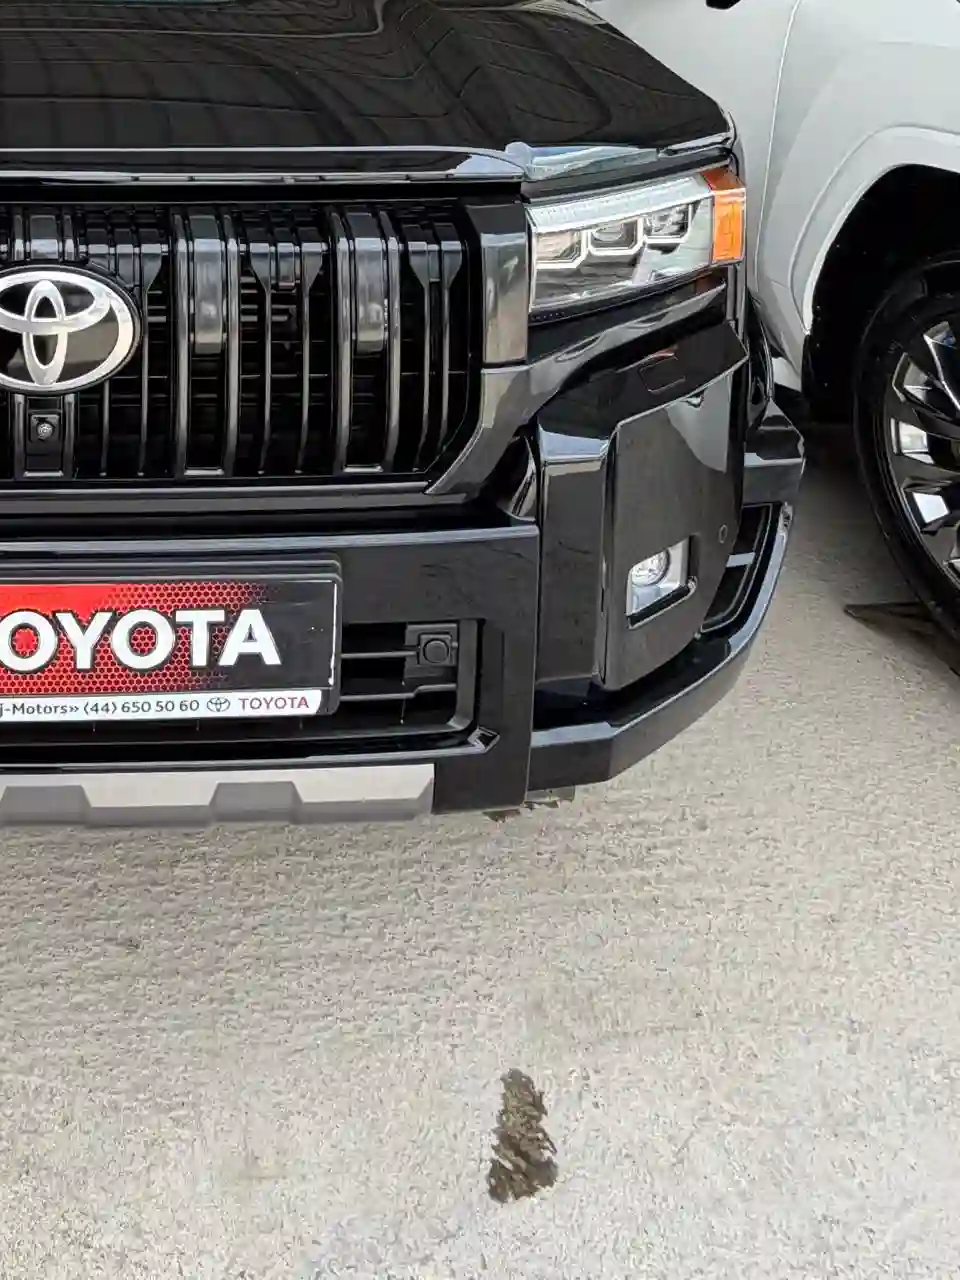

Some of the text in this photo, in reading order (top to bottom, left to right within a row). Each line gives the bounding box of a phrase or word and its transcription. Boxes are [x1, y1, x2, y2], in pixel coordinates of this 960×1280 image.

[121, 700, 151, 713] 650
[156, 700, 175, 712] 50
[179, 699, 200, 712] 60
[238, 696, 309, 710] TOYOTA
